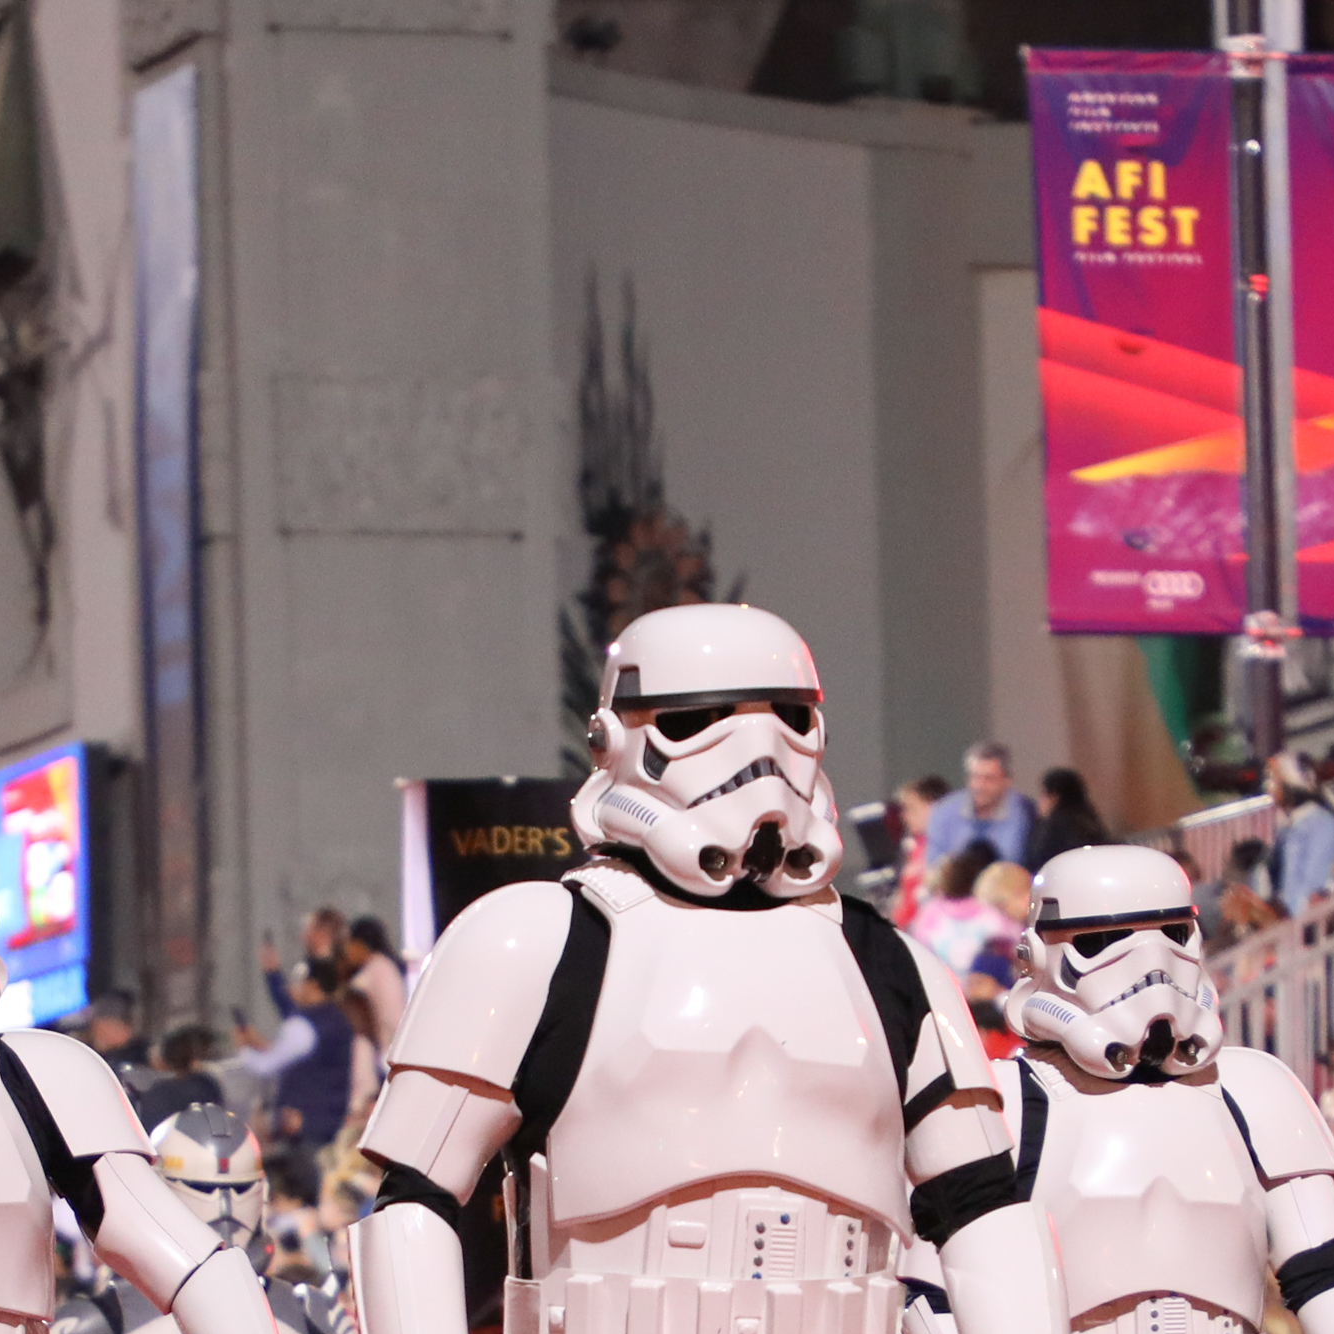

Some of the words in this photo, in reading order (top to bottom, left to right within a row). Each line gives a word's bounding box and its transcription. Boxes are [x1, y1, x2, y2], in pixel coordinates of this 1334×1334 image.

[1072, 159, 1166, 200] AFI
[1071, 205, 1200, 247] FEST
[450, 824, 573, 857] VADER'S
